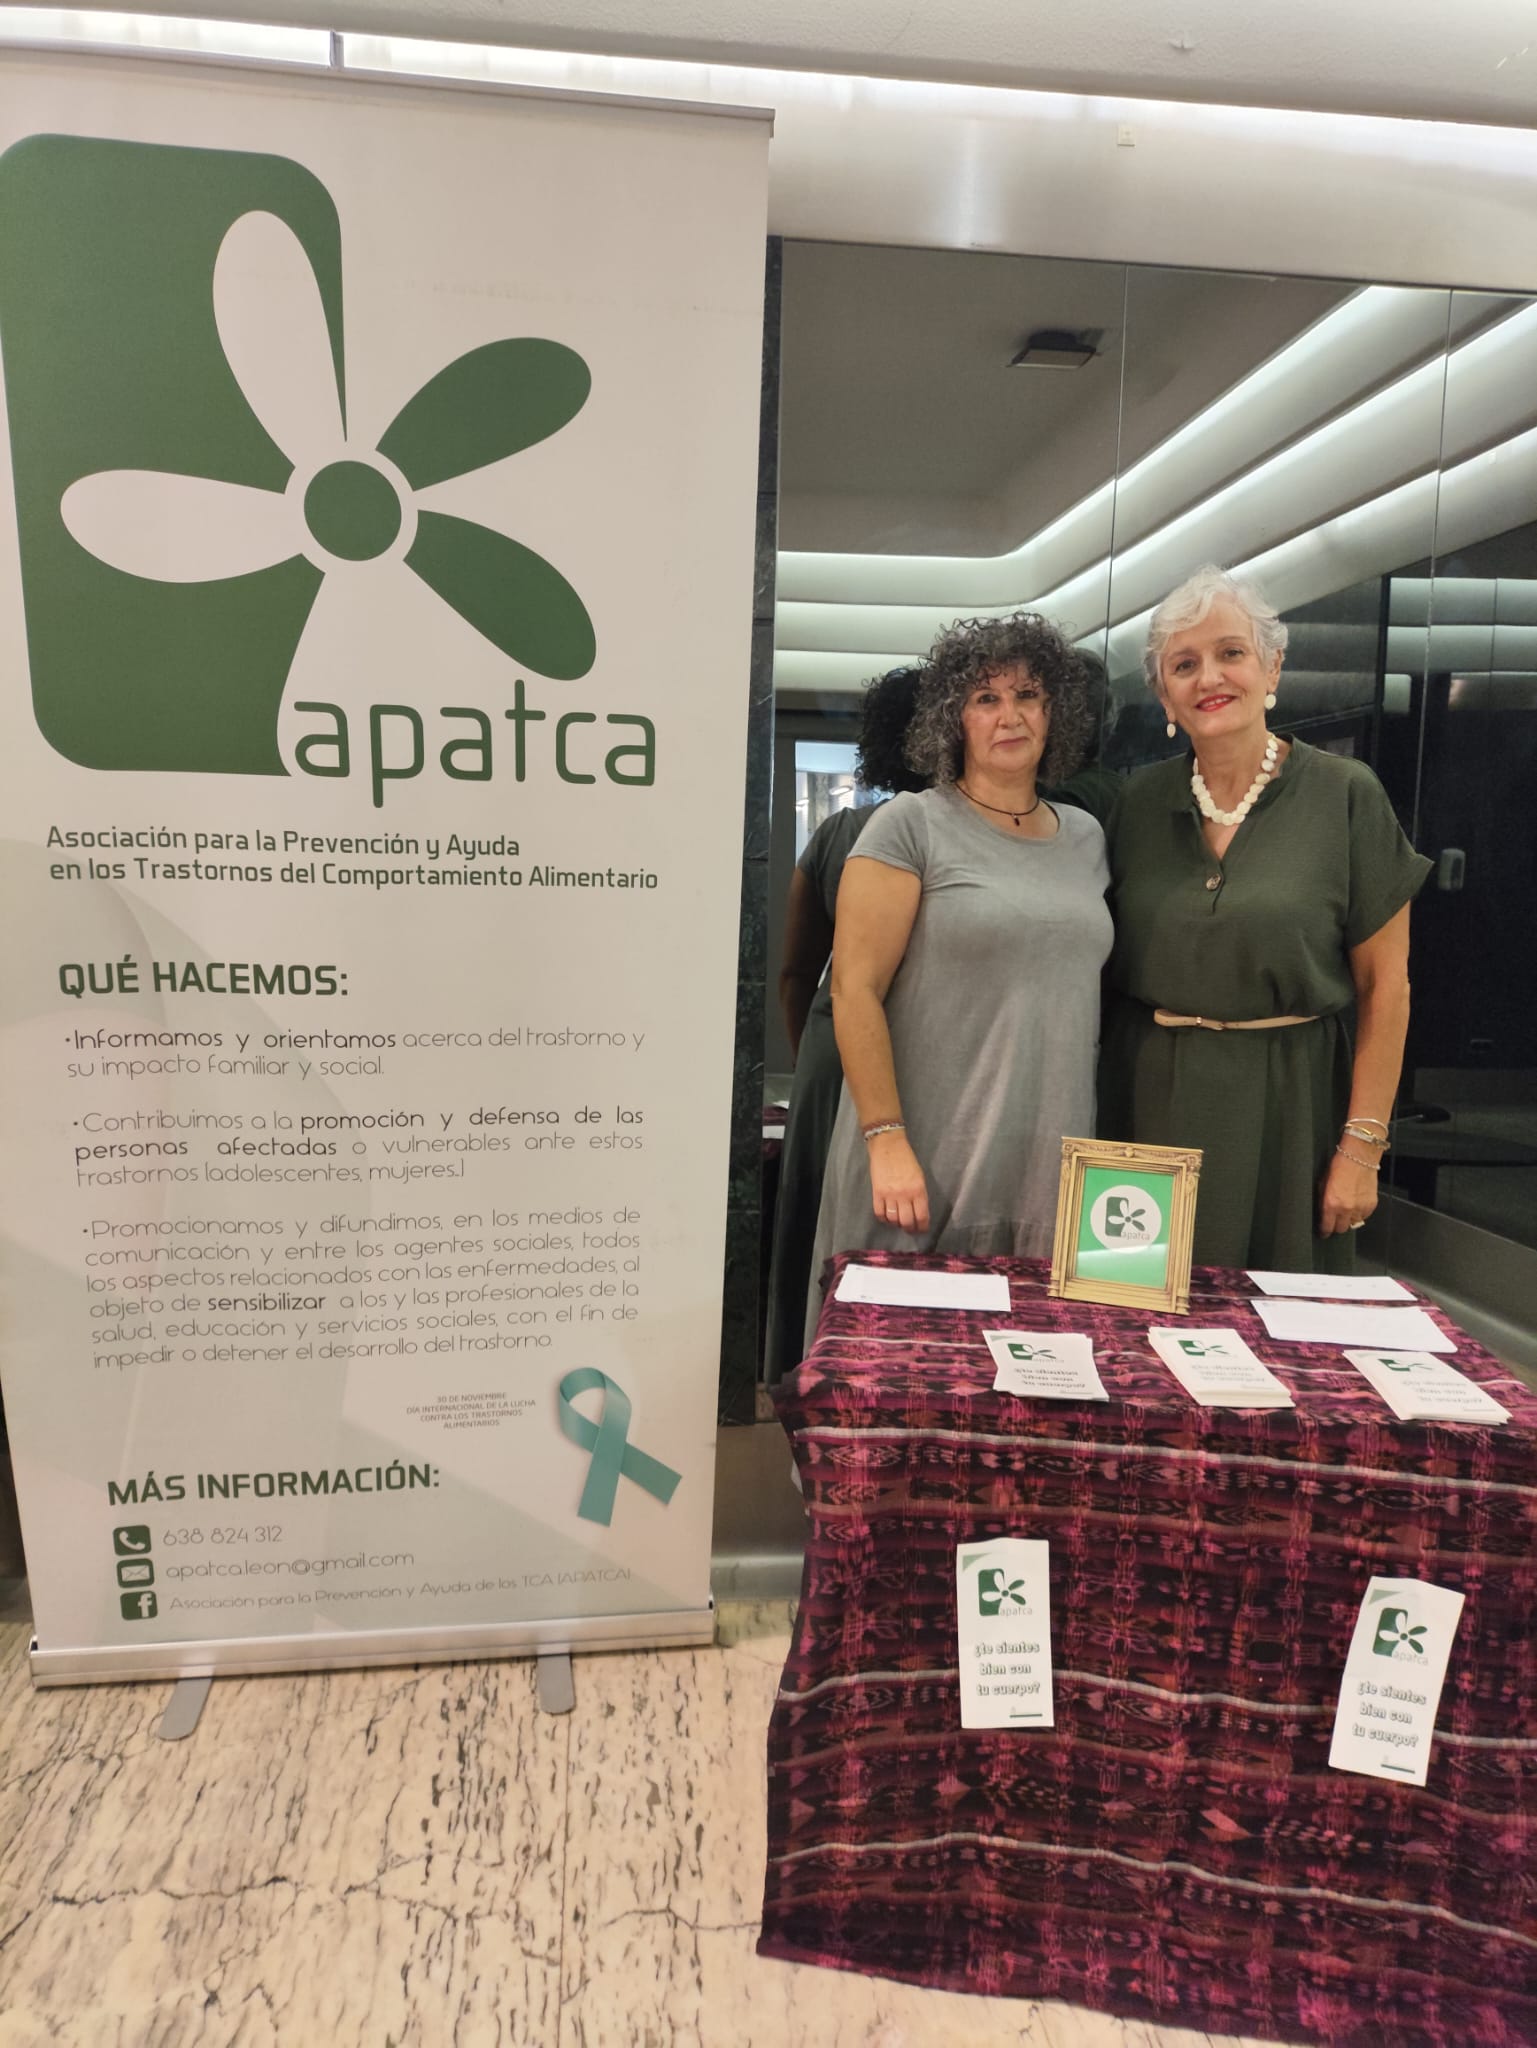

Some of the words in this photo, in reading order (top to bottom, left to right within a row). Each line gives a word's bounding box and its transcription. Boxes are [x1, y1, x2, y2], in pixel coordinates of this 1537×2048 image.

[294, 679, 655, 808] apatca
[47, 826, 187, 848] Asociación
[195, 833, 248, 854] para
[256, 830, 276, 851] la
[284, 831, 419, 854] Prevención
[427, 840, 439, 860] y
[446, 834, 519, 860] Ayuda
[50, 864, 81, 880] en
[89, 858, 125, 879] los
[133, 858, 272, 882] Trastornos
[280, 862, 315, 883] del
[323, 863, 522, 890] Comportamiento
[529, 866, 657, 888] Alimentario
[59, 954, 139, 999] QUÉ
[153, 962, 348, 995] HACEMOS:
[236, 1034, 250, 1053] y
[264, 1029, 396, 1048] orientamos
[403, 1033, 482, 1047] acerca
[488, 1027, 520, 1046] del
[527, 1026, 625, 1046] trastorno
[632, 1033, 645, 1052] y
[67, 1063, 94, 1078] su
[101, 1054, 200, 1080] impacto
[208, 1054, 290, 1075] familiar
[298, 1061, 312, 1080] y
[320, 1056, 384, 1075] social.
[251, 1116, 266, 1129] a
[274, 1111, 293, 1129] la
[301, 1109, 424, 1135] promoción
[440, 1113, 453, 1132] y
[469, 1106, 559, 1125] defensa
[574, 1105, 602, 1123] de
[617, 1105, 643, 1123] las
[75, 1141, 188, 1166] personas
[217, 1137, 336, 1156] afectadas
[352, 1141, 366, 1155] o
[382, 1133, 510, 1154] vulnerables
[525, 1131, 575, 1150] ante
[589, 1131, 642, 1149] estos
[77, 1165, 198, 1187] trastornos
[295, 1221, 308, 1239] y
[320, 1212, 443, 1233] difundimos,
[454, 1215, 483, 1230] en
[493, 1208, 519, 1226] los
[529, 1206, 603, 1224] medios
[613, 1205, 640, 1223] de
[85, 1241, 250, 1266] comunicación
[260, 1248, 274, 1266] y
[285, 1240, 346, 1260] entre
[357, 1240, 384, 1258] los
[394, 1235, 483, 1261] agentes
[493, 1232, 574, 1252] sociales,
[583, 1230, 640, 1248] todos
[86, 1275, 116, 1293] los
[122, 1267, 225, 1293] aspectos
[230, 1265, 373, 1286] relacionados
[377, 1267, 420, 1282] con
[425, 1262, 452, 1279] las
[457, 1256, 618, 1278] enfermedades,
[623, 1256, 640, 1272] al
[90, 1296, 164, 1322] objeto
[171, 1293, 200, 1312] de
[208, 1292, 326, 1311] sensibilizar
[340, 1296, 354, 1309] a
[360, 1289, 387, 1308] los
[394, 1293, 406, 1311] y
[413, 1288, 439, 1304] las
[446, 1281, 583, 1309] profesionales
[589, 1280, 616, 1297] de
[623, 1280, 639, 1296] la
[92, 1321, 156, 1344] salud,
[165, 1318, 285, 1337] educación
[296, 1323, 308, 1340] y
[318, 1314, 408, 1334] servicios
[417, 1309, 498, 1329] sociales,
[507, 1311, 547, 1324] con
[556, 1304, 572, 1322] el
[581, 1304, 604, 1320] fin
[611, 1304, 638, 1320] de
[94, 1344, 175, 1371] impedir
[182, 1349, 197, 1362] o
[202, 1344, 288, 1361] detener
[296, 1342, 313, 1360] el
[318, 1337, 418, 1359] desarrollo
[424, 1336, 454, 1353] del
[459, 1332, 552, 1352] trastorno.
[108, 1471, 185, 1506] MÁS
[198, 1459, 439, 1499] INFORMACIÓN:
[163, 1528, 204, 1546] 638
[210, 1528, 248, 1544] 824
[255, 1525, 282, 1543] 312
[166, 1552, 414, 1582] apatca.leon@gmail.com
